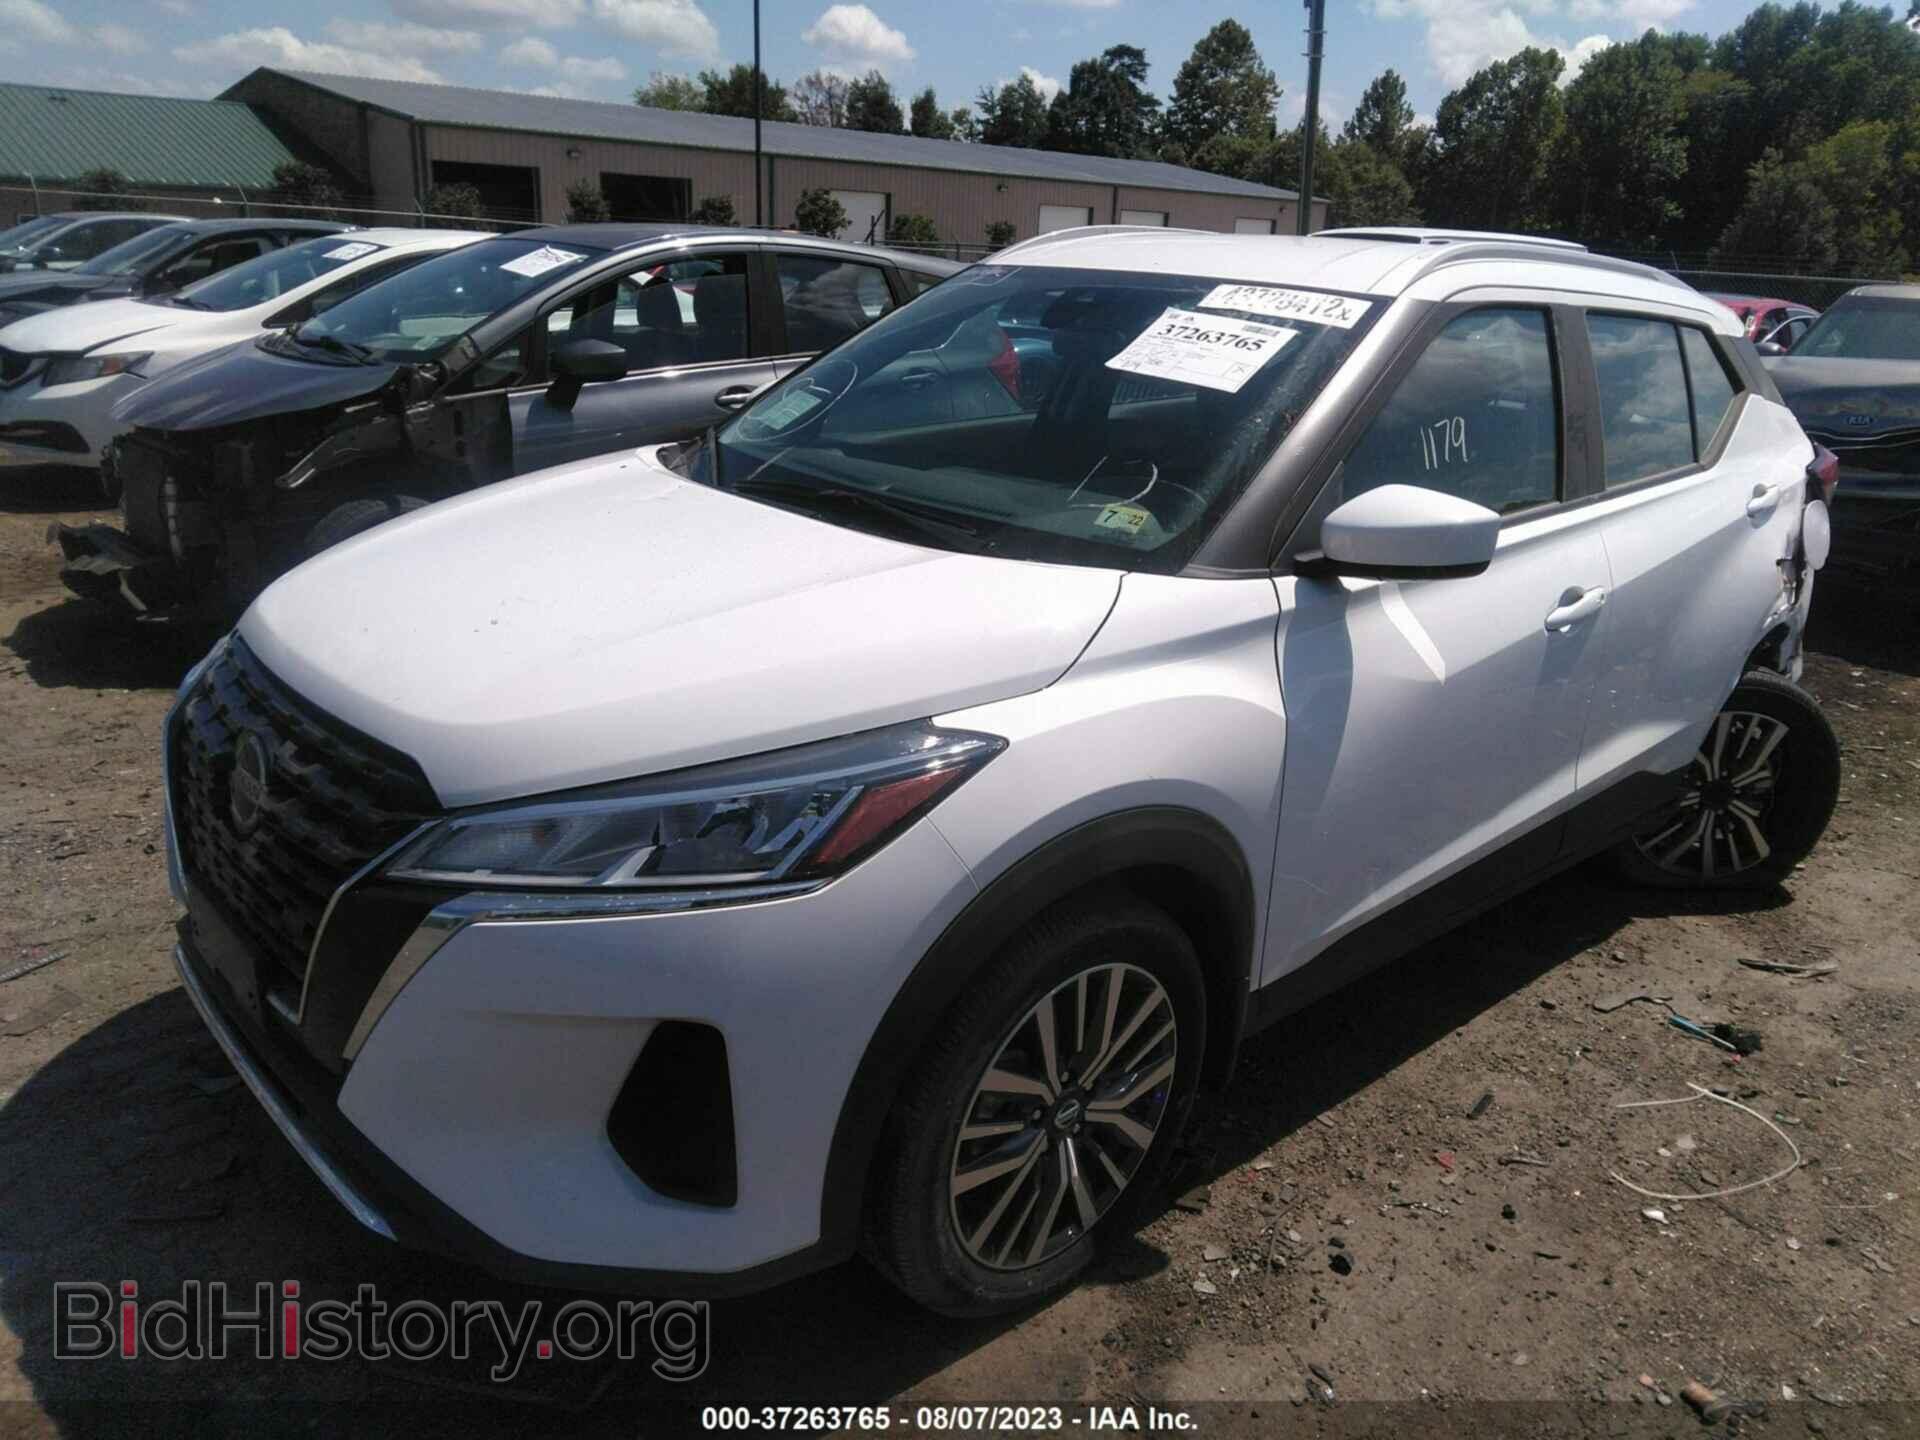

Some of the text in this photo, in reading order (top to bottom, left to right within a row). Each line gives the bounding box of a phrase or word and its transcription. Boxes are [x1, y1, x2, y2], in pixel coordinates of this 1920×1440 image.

[1157, 323, 1268, 352] 37263765
[1848, 415, 1871, 425] KIA
[1420, 416, 1468, 470] 1179
[1104, 509, 1118, 523] 7
